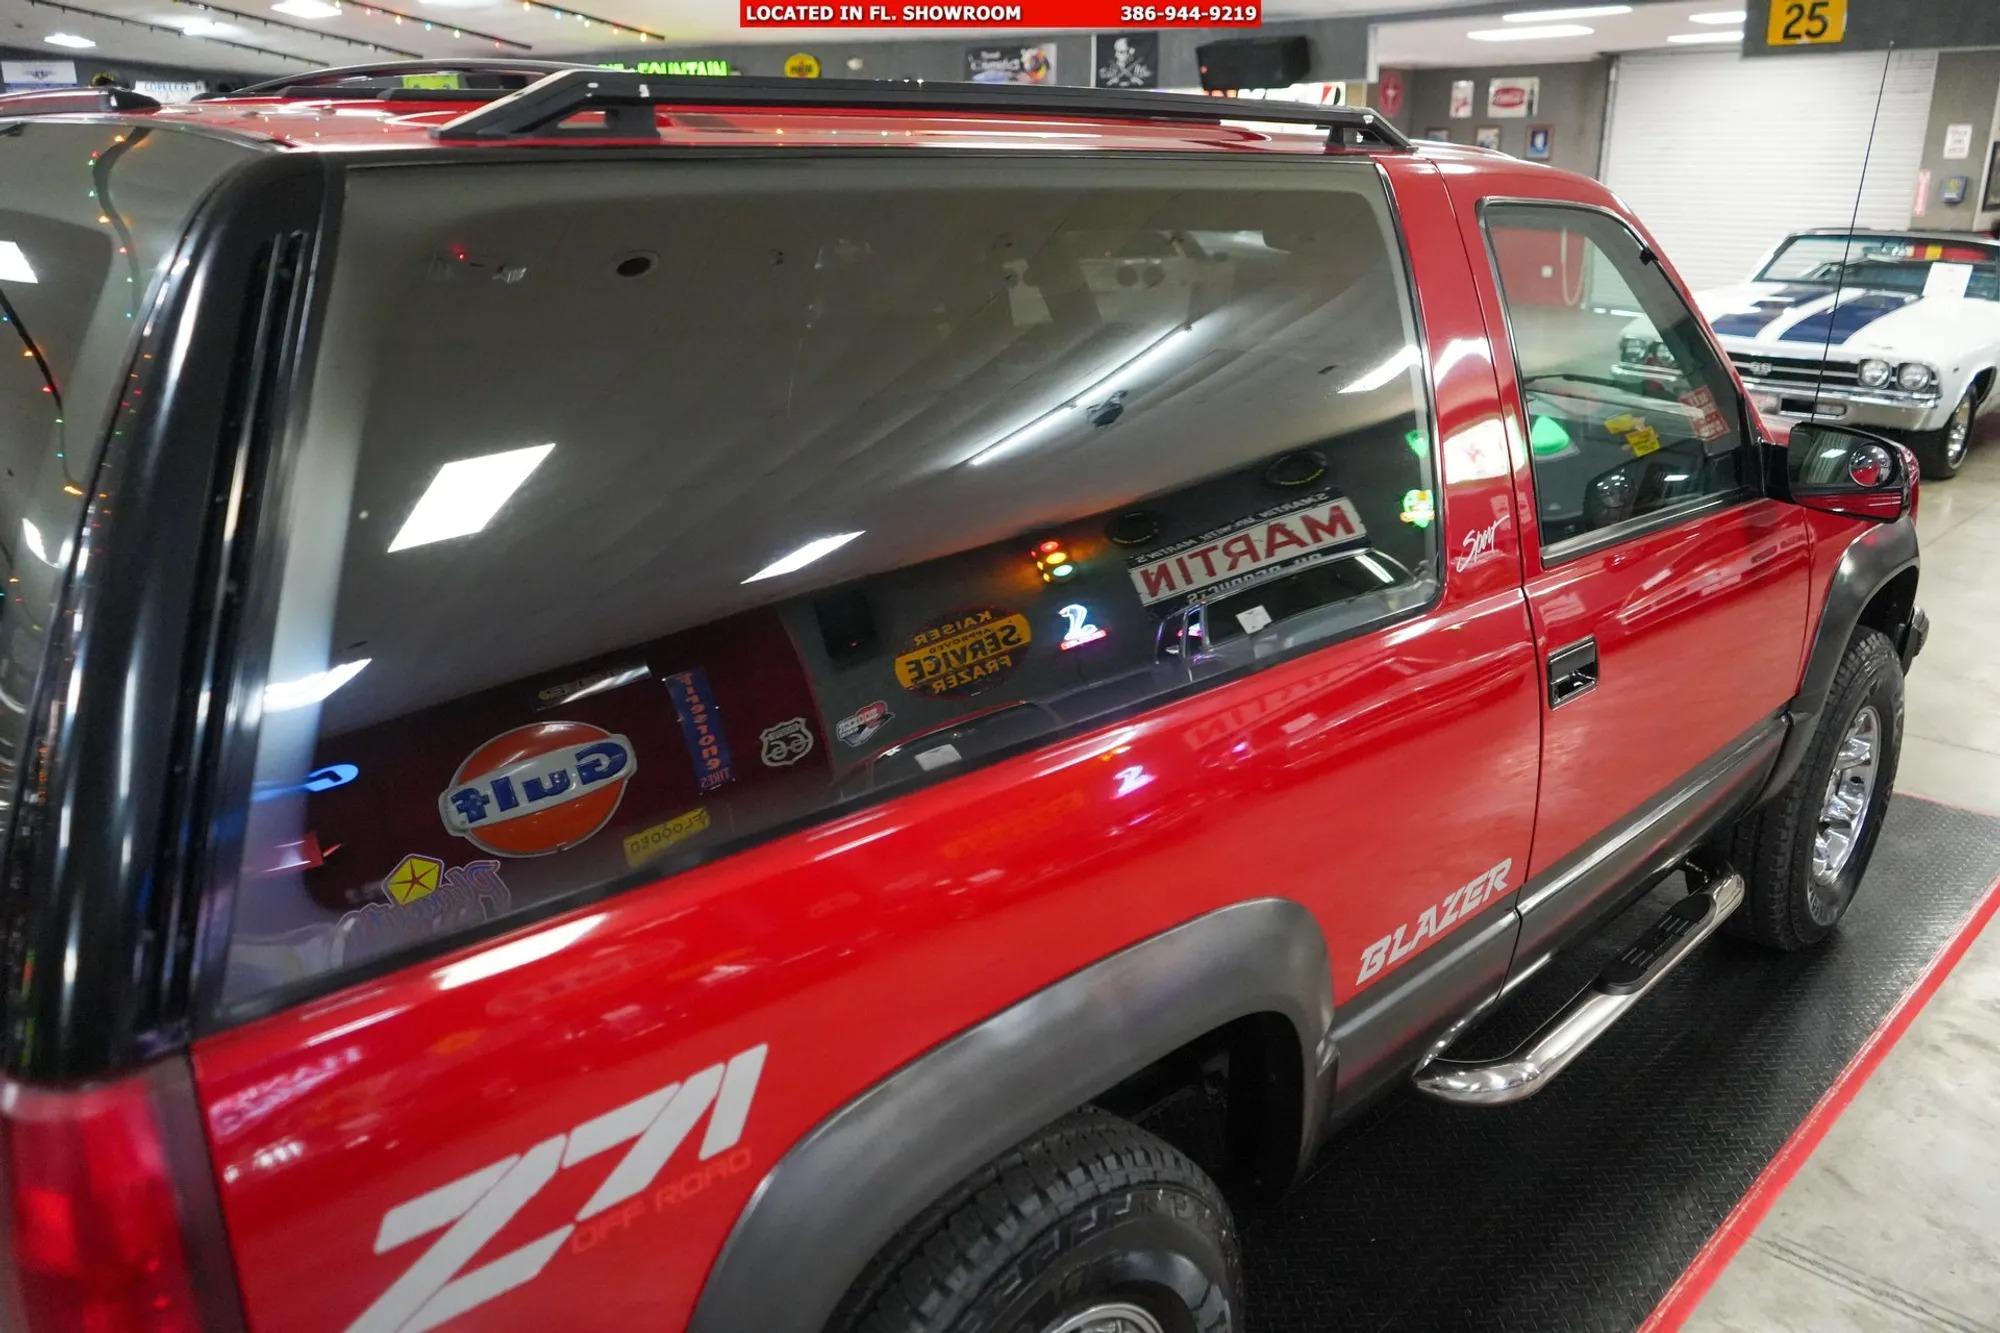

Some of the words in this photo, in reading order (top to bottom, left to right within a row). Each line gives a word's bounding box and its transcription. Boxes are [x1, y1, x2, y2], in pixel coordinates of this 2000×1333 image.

[1783, 2, 1829, 39] 25
[1356, 857, 1512, 986] BLAZER
[343, 1043, 768, 1333] Z71
[571, 1203, 645, 1255] OFF
[655, 1146, 753, 1213] ROAD
